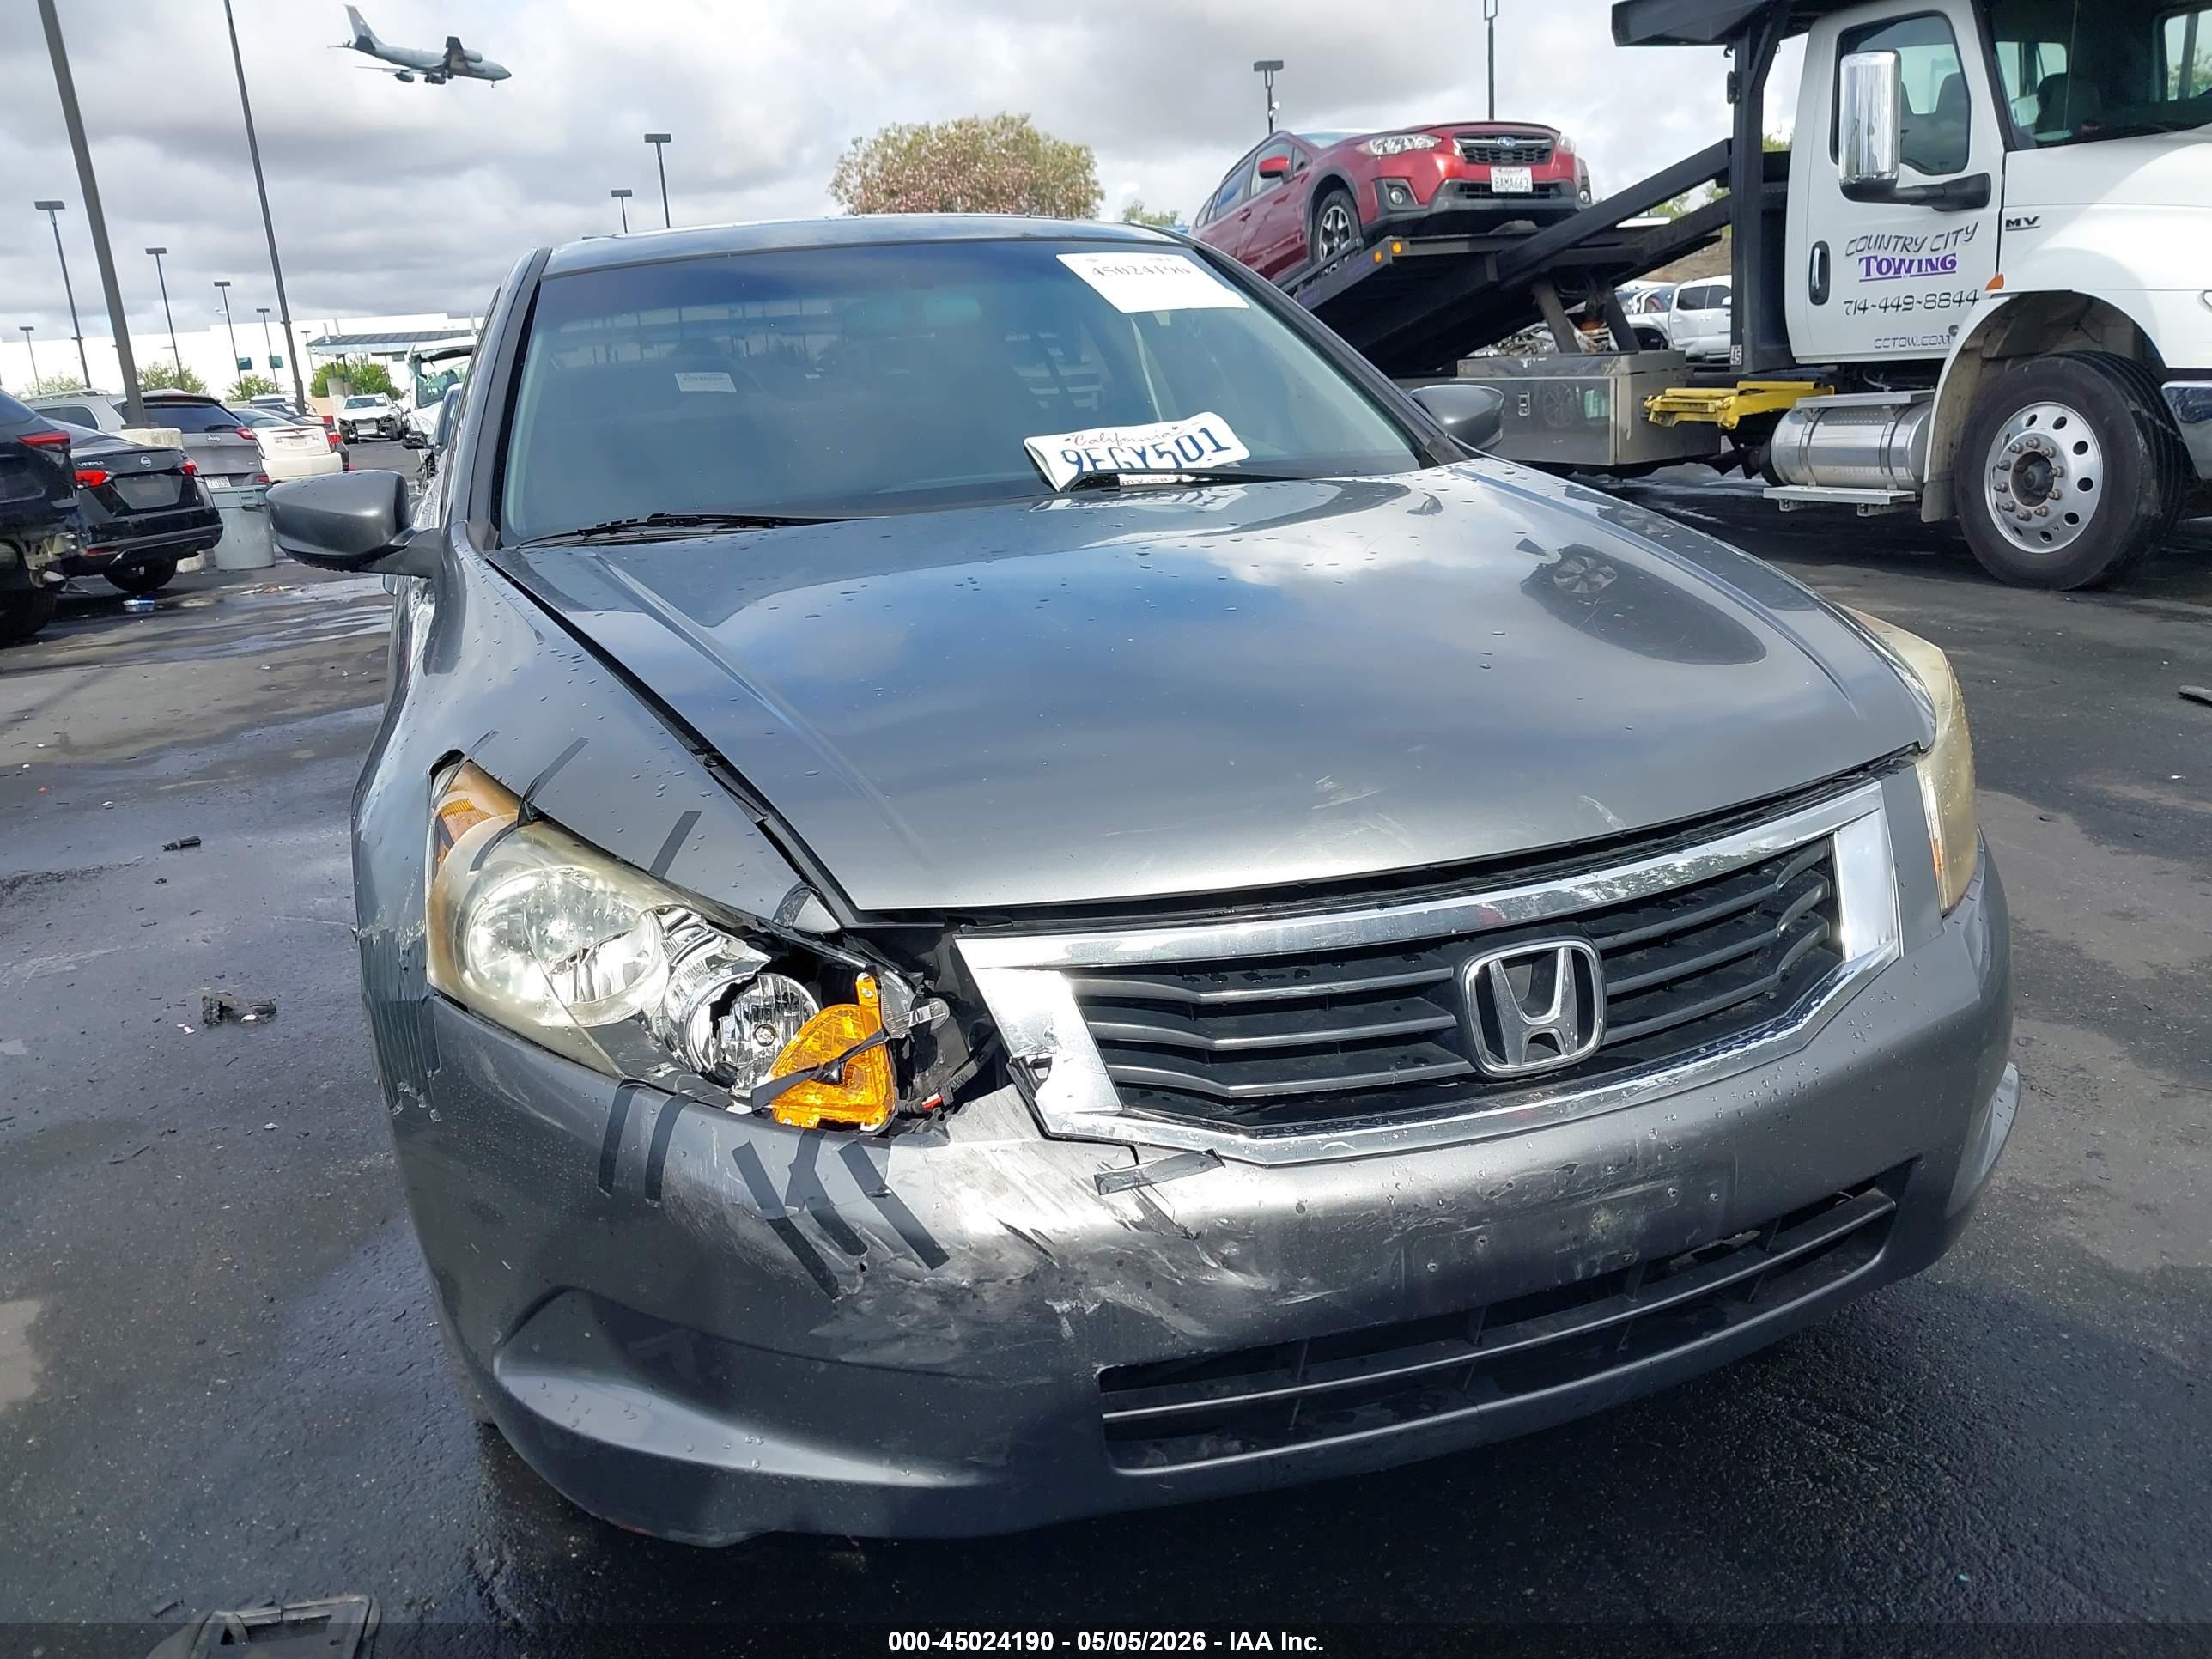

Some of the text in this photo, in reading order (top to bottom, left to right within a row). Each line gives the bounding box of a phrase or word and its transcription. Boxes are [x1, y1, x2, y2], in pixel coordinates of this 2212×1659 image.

[2005, 216, 2041, 228] MV
[1845, 221, 1979, 257] COUNTRY CITY
[1858, 252, 1957, 276] TOWING
